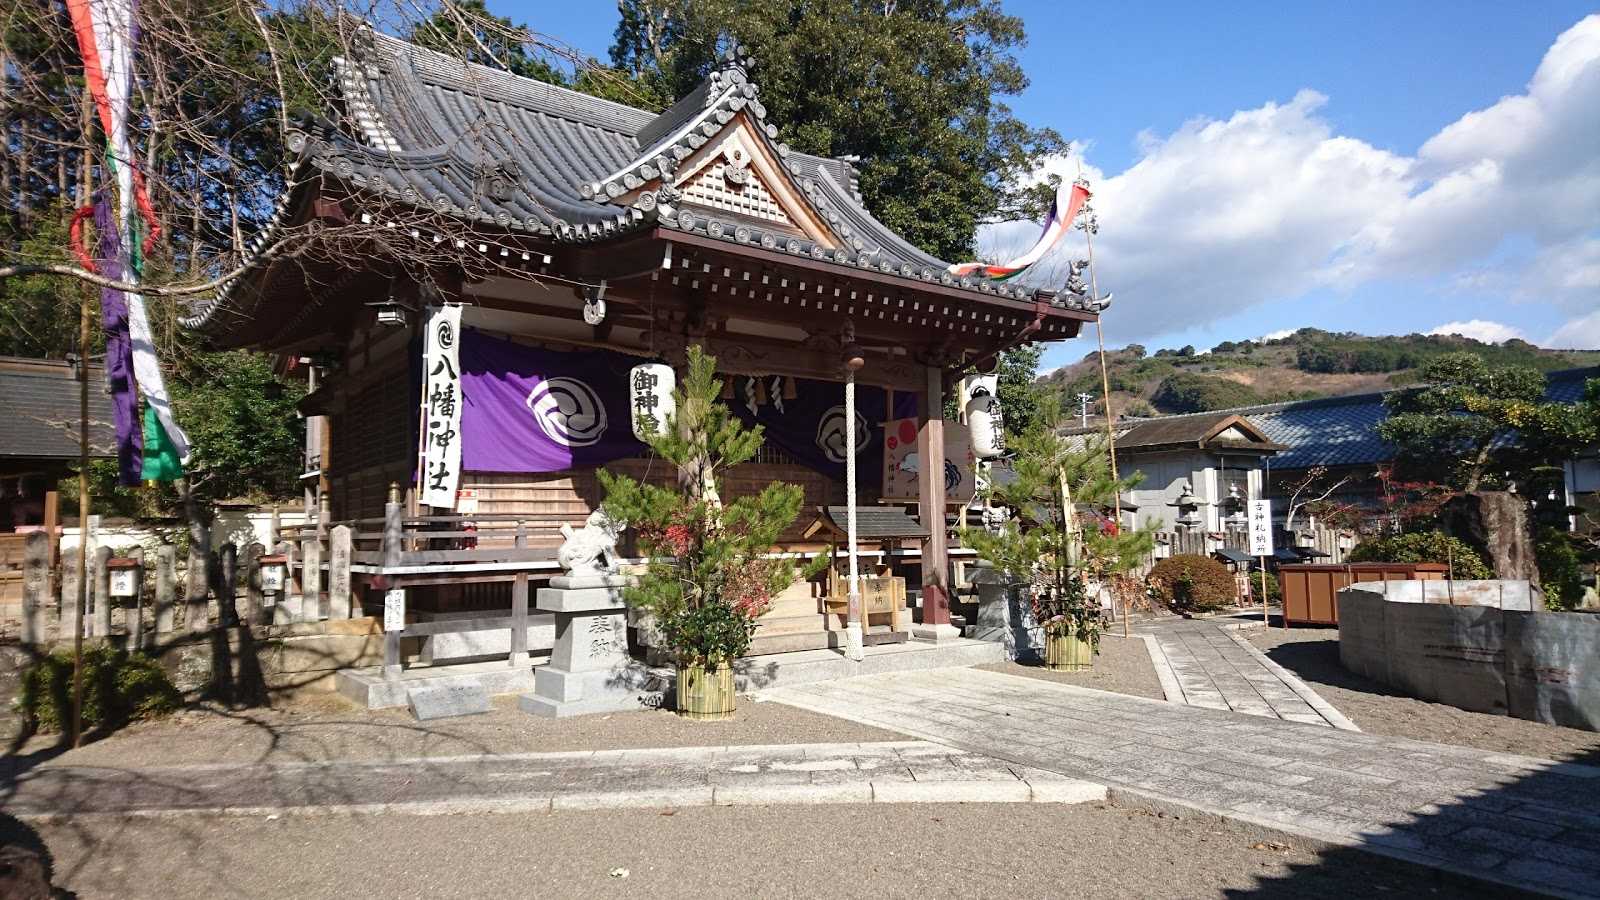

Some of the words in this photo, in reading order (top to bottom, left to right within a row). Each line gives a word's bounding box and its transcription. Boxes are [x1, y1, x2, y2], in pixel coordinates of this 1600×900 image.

[430, 353, 458, 491] 八幡神社
[1254, 502, 1266, 553] 古神札納所
[588, 616, 612, 658] 奉納
